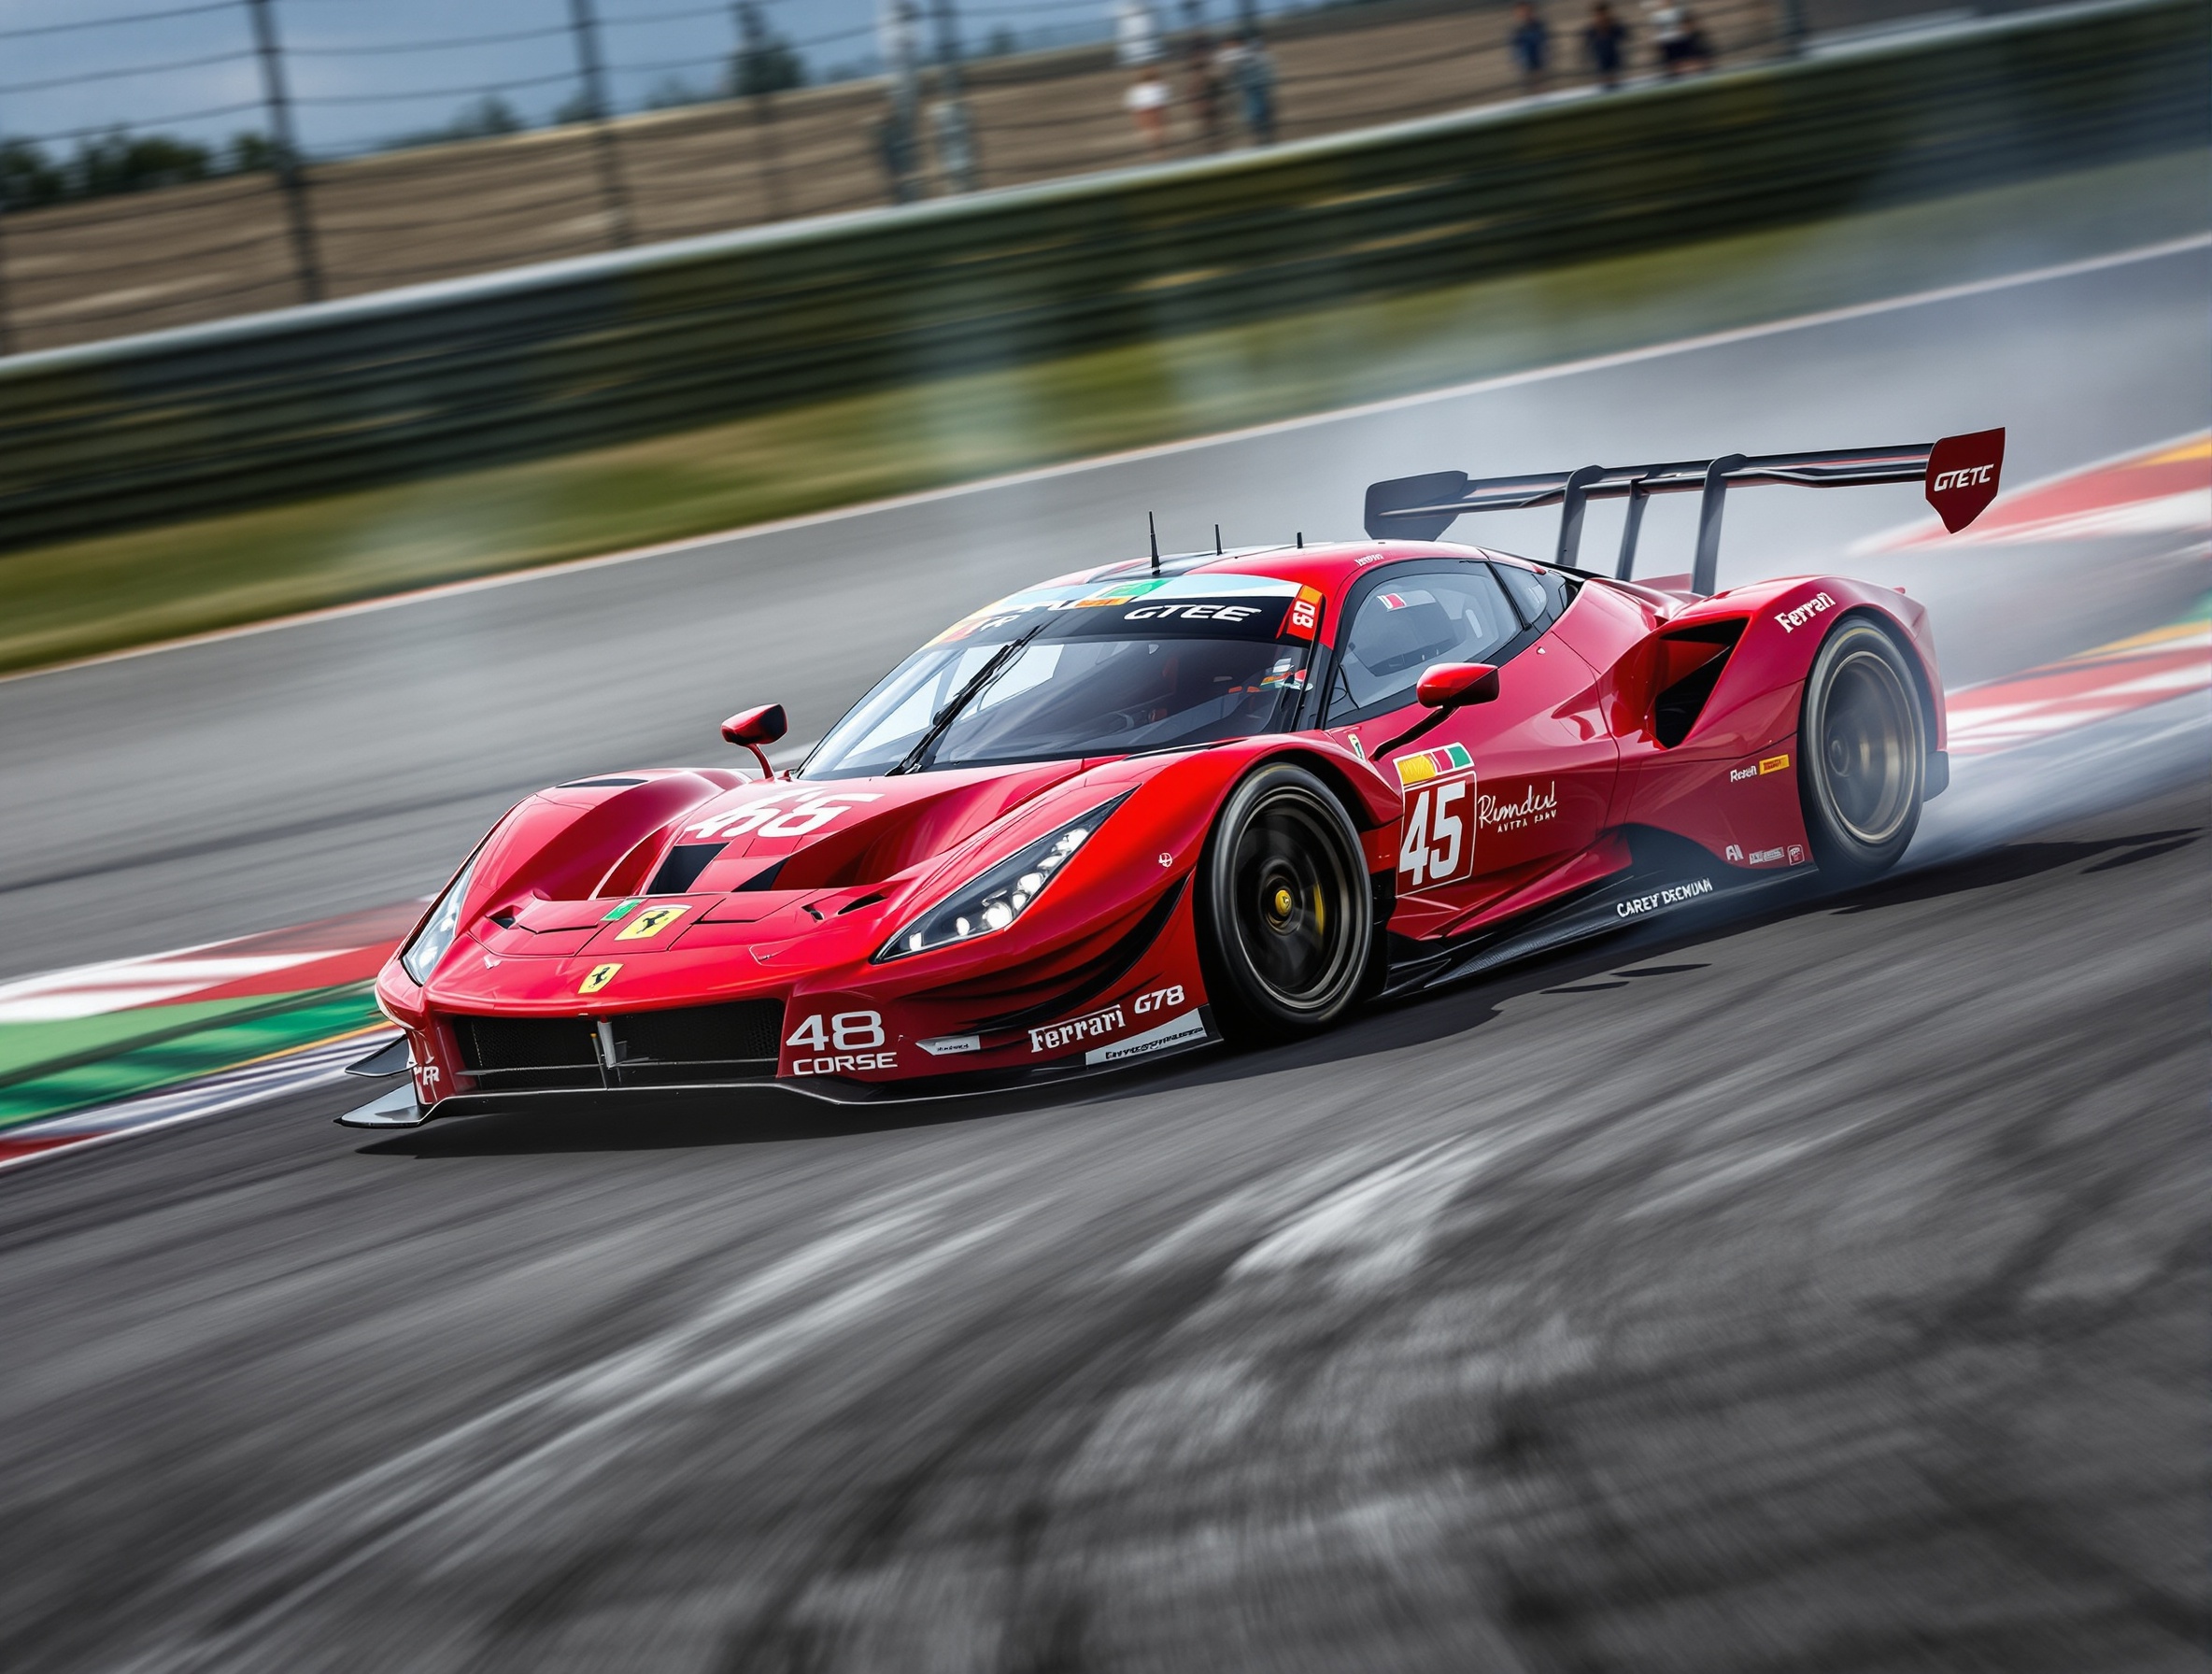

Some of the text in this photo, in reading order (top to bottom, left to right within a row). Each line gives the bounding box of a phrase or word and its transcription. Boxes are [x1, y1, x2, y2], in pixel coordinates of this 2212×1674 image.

[1124, 604, 1262, 622] GTEE
[1399, 780, 1466, 886] 45
[786, 1010, 886, 1051] 48
[1028, 1004, 1126, 1054] Ferrari
[1134, 984, 1184, 1014] G78
[792, 1051, 898, 1076] CORSE
